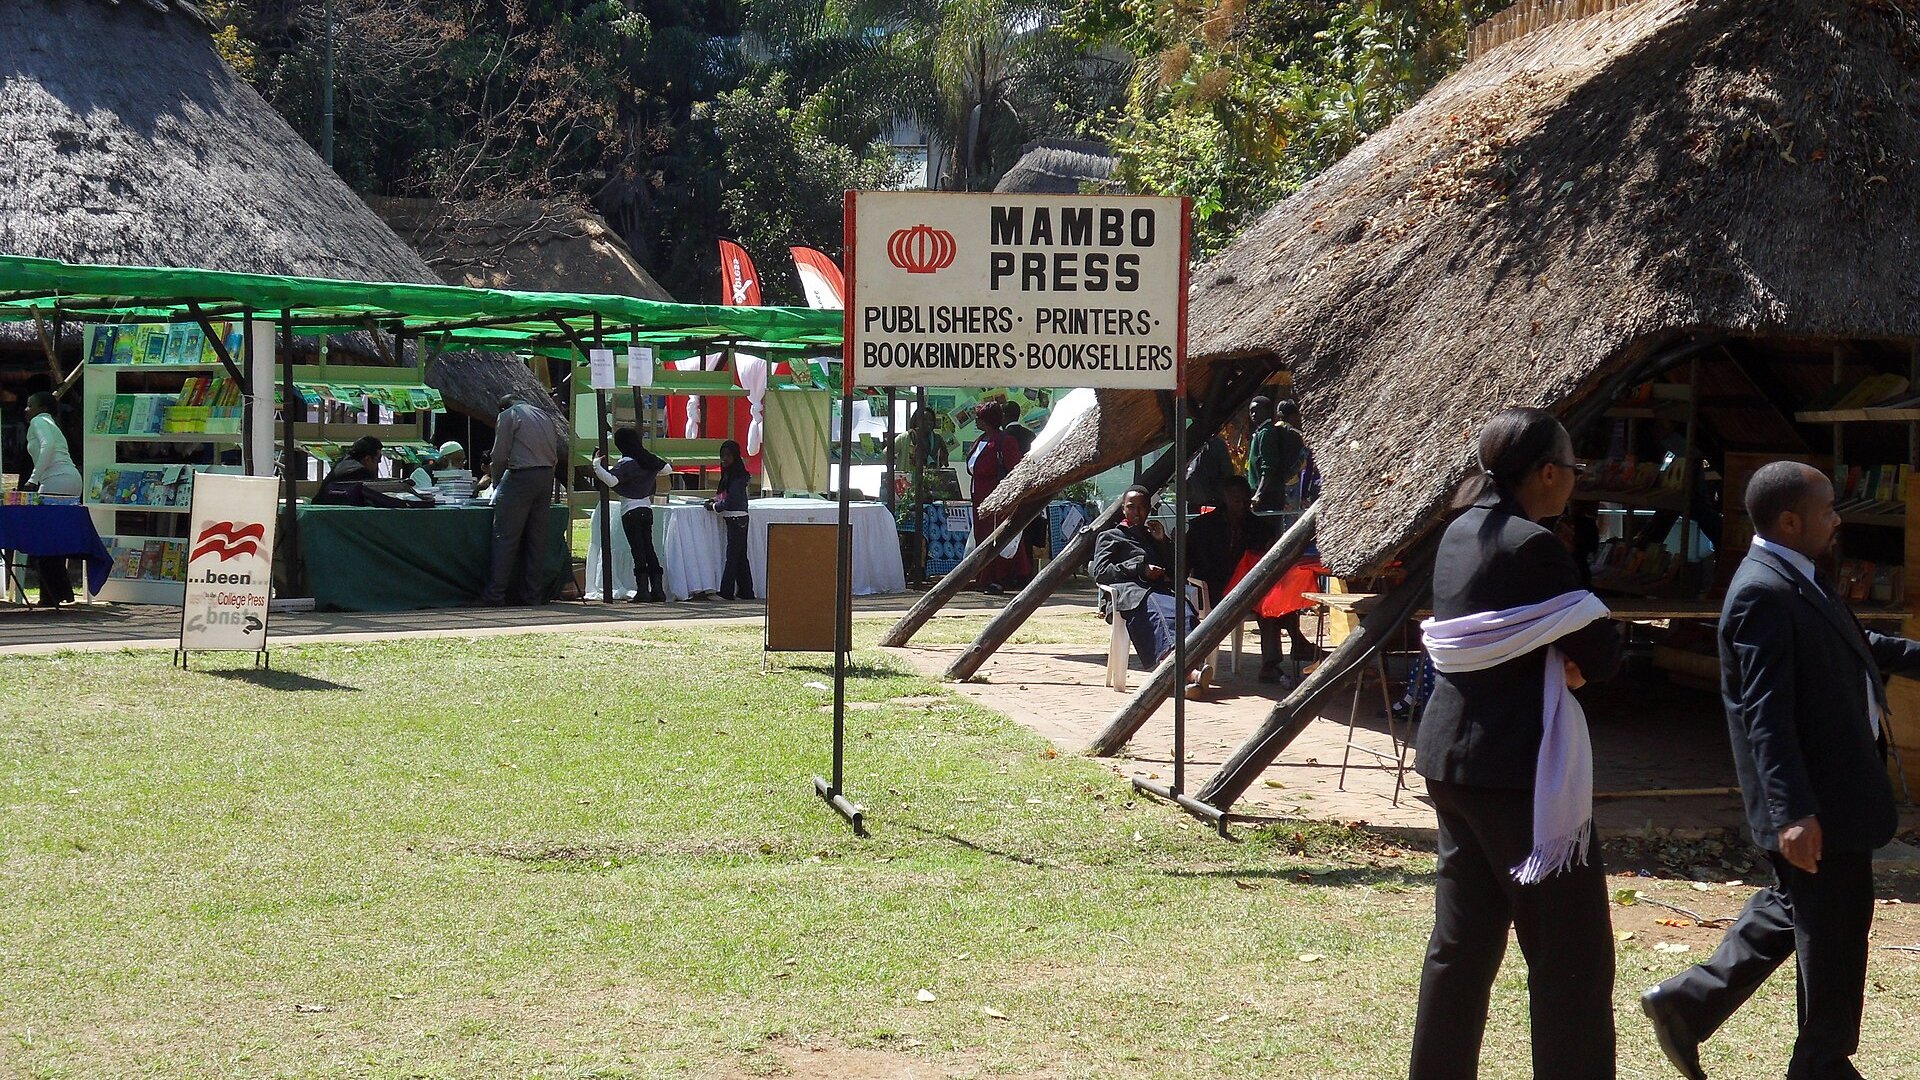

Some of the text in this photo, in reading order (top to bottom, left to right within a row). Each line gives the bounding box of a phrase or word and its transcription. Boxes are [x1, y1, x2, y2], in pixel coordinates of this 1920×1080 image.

[990, 206, 1156, 248] MAMBO
[990, 251, 1141, 292] PRESS
[217, 592, 246, 609] College
[247, 593, 265, 607] Press
